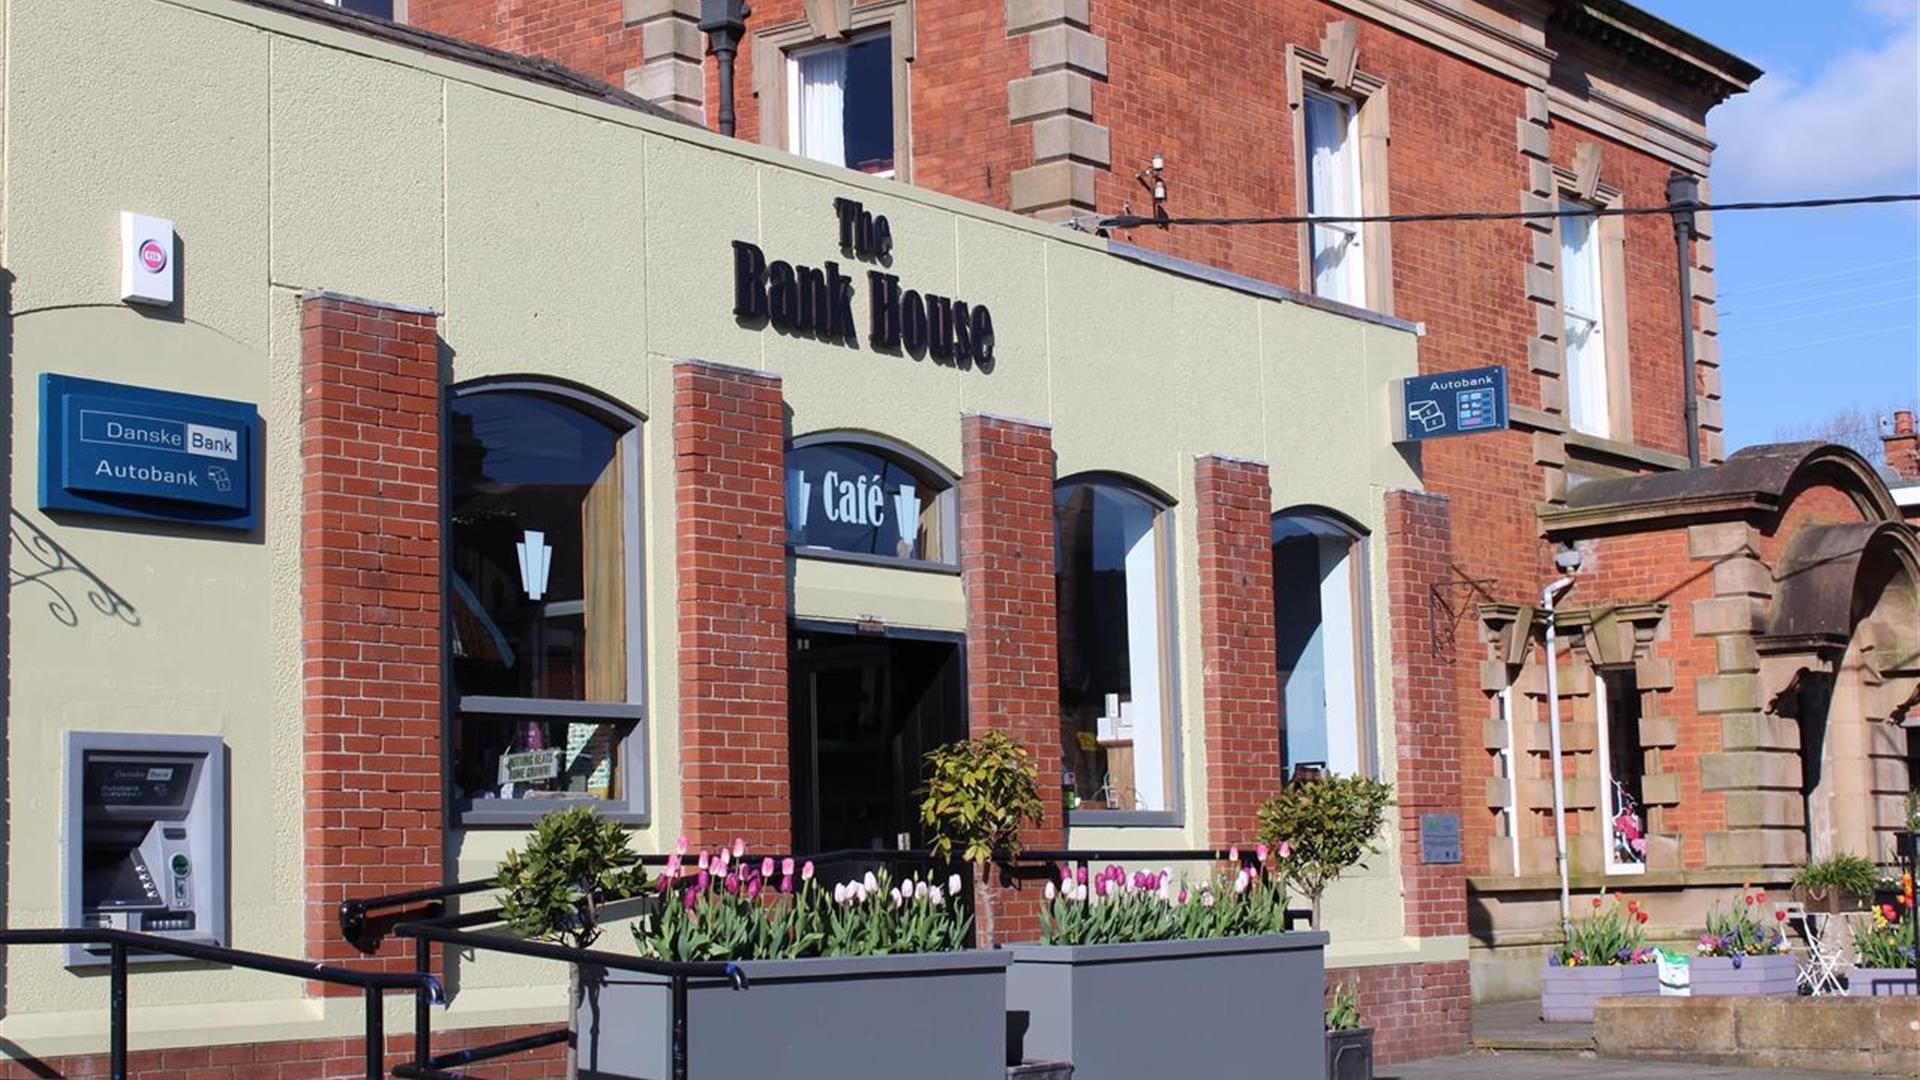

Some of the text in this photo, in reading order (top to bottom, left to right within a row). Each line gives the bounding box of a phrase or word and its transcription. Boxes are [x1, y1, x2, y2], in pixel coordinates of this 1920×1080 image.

[833, 197, 892, 264] The
[732, 240, 994, 370] Bank House
[1430, 376, 1493, 391] Autobank
[107, 422, 233, 453] Danske Bank
[96, 460, 198, 487] Autobank
[823, 470, 884, 526] Café
